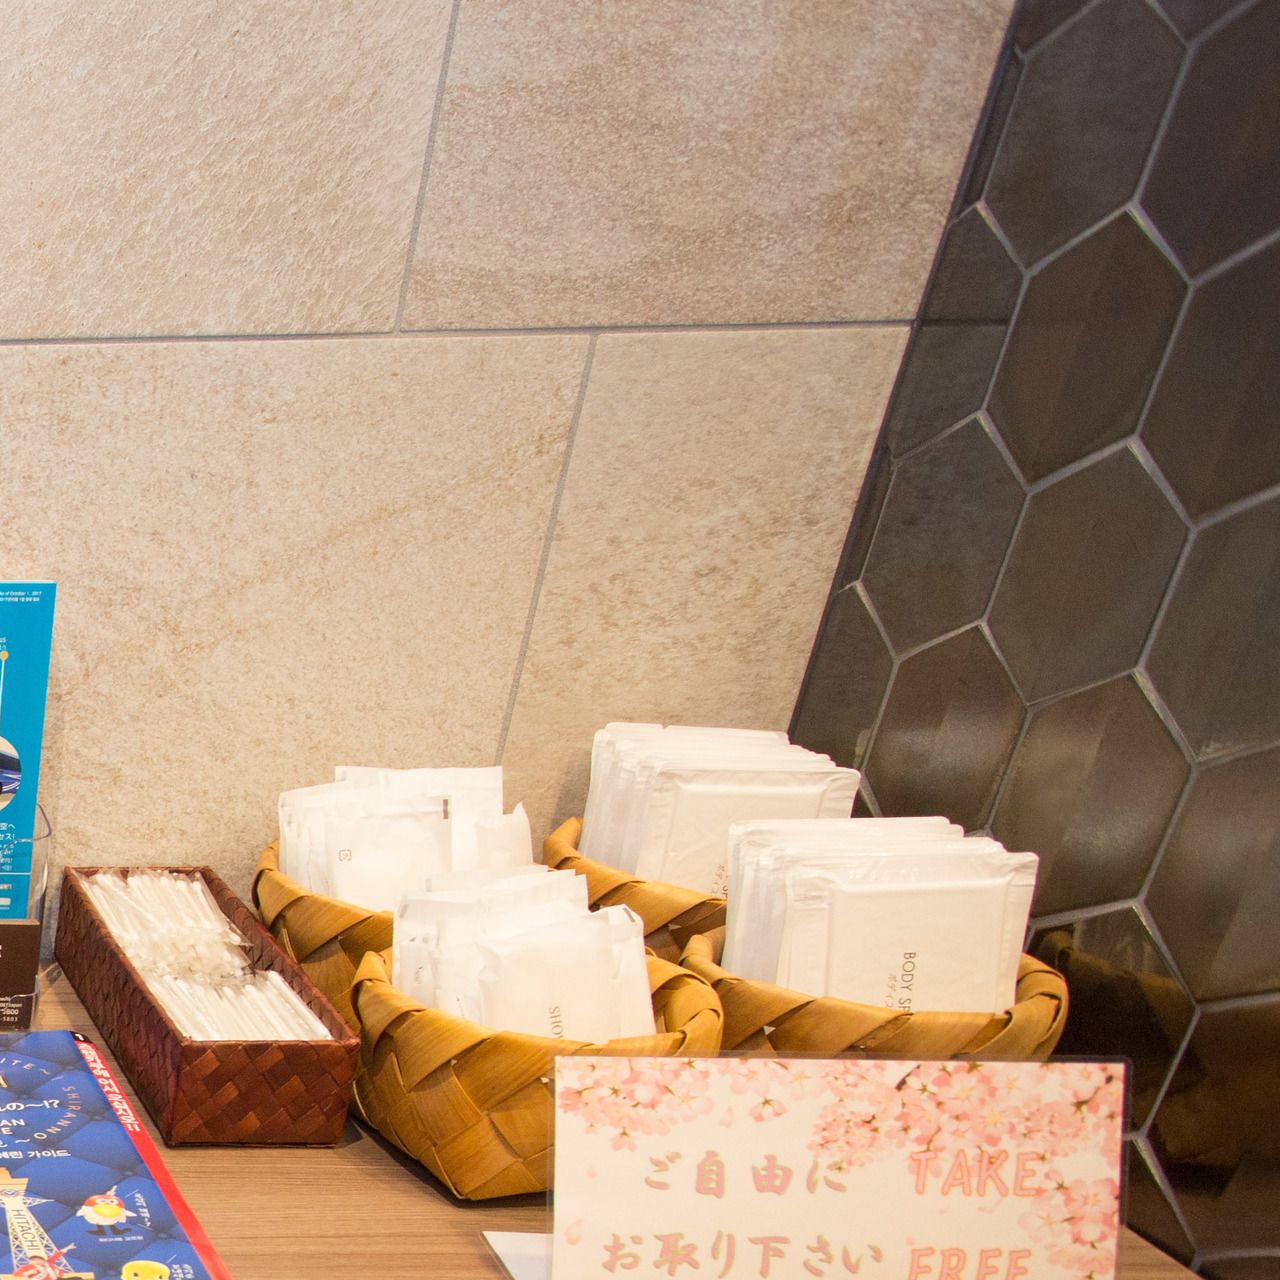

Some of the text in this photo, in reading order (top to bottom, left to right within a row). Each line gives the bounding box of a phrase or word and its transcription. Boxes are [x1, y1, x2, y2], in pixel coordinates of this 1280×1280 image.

[900, 951, 917, 992] BODY
[548, 1005, 564, 1040] SHO
[28, 1149, 72, 1159] 가이드
[643, 1148, 1042, 1198] ご自由に TAKE
[12, 1209, 41, 1251] HITACHI
[601, 1231, 885, 1279] お取り下さい
